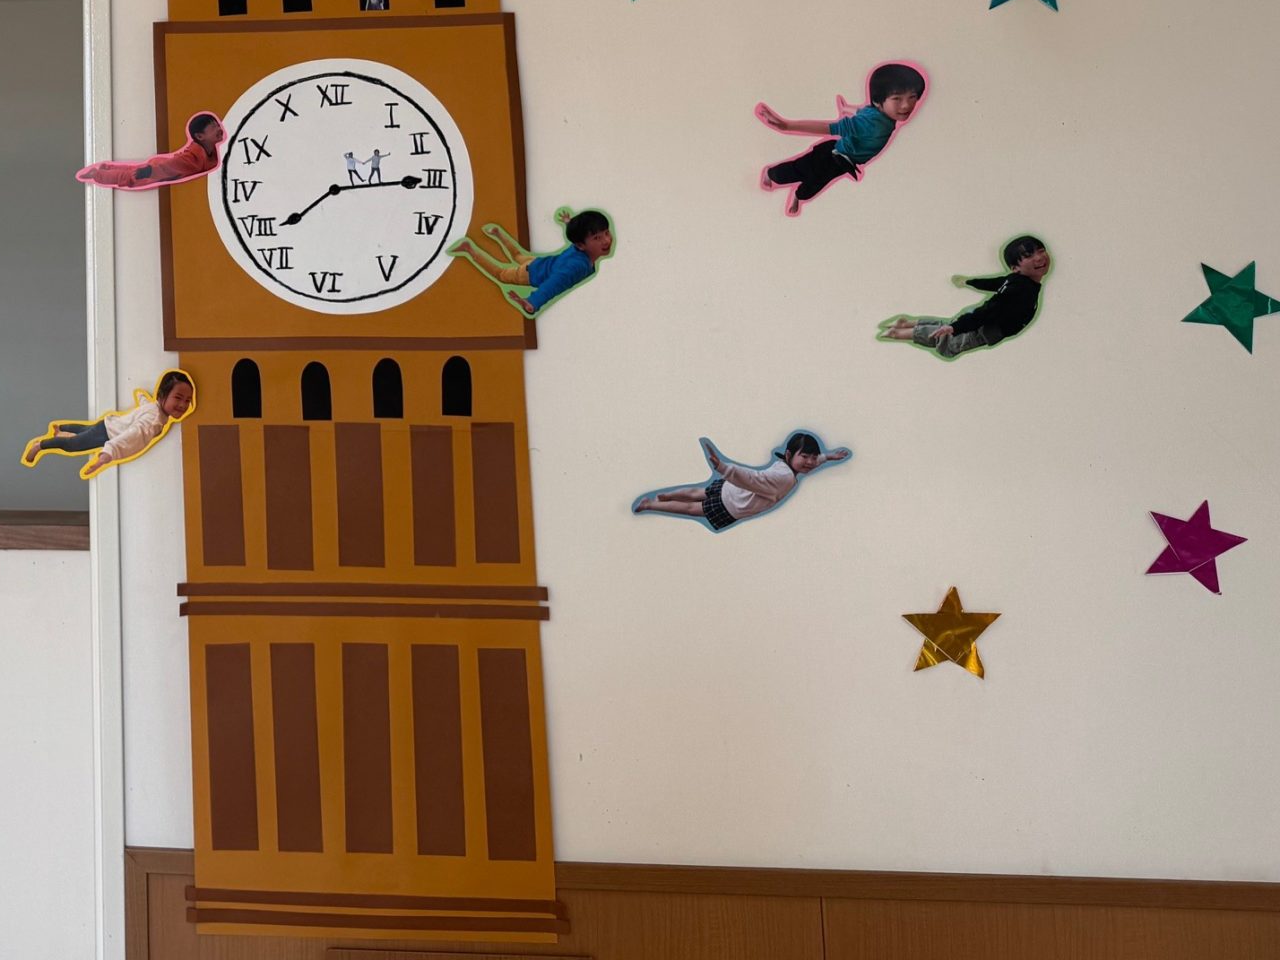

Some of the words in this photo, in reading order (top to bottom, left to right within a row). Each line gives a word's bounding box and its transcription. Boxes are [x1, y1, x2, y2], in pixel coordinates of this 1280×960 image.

[275, 94, 299, 121] X
[385, 103, 400, 128] I
[238, 135, 272, 164] IX
[409, 132, 431, 155] II
[231, 179, 263, 202] IV
[419, 169, 449, 189] III
[237, 215, 277, 238] VIII
[413, 212, 443, 235] IV
[257, 247, 294, 269] VII
[375, 255, 398, 281] V
[308, 272, 343, 293] VI
